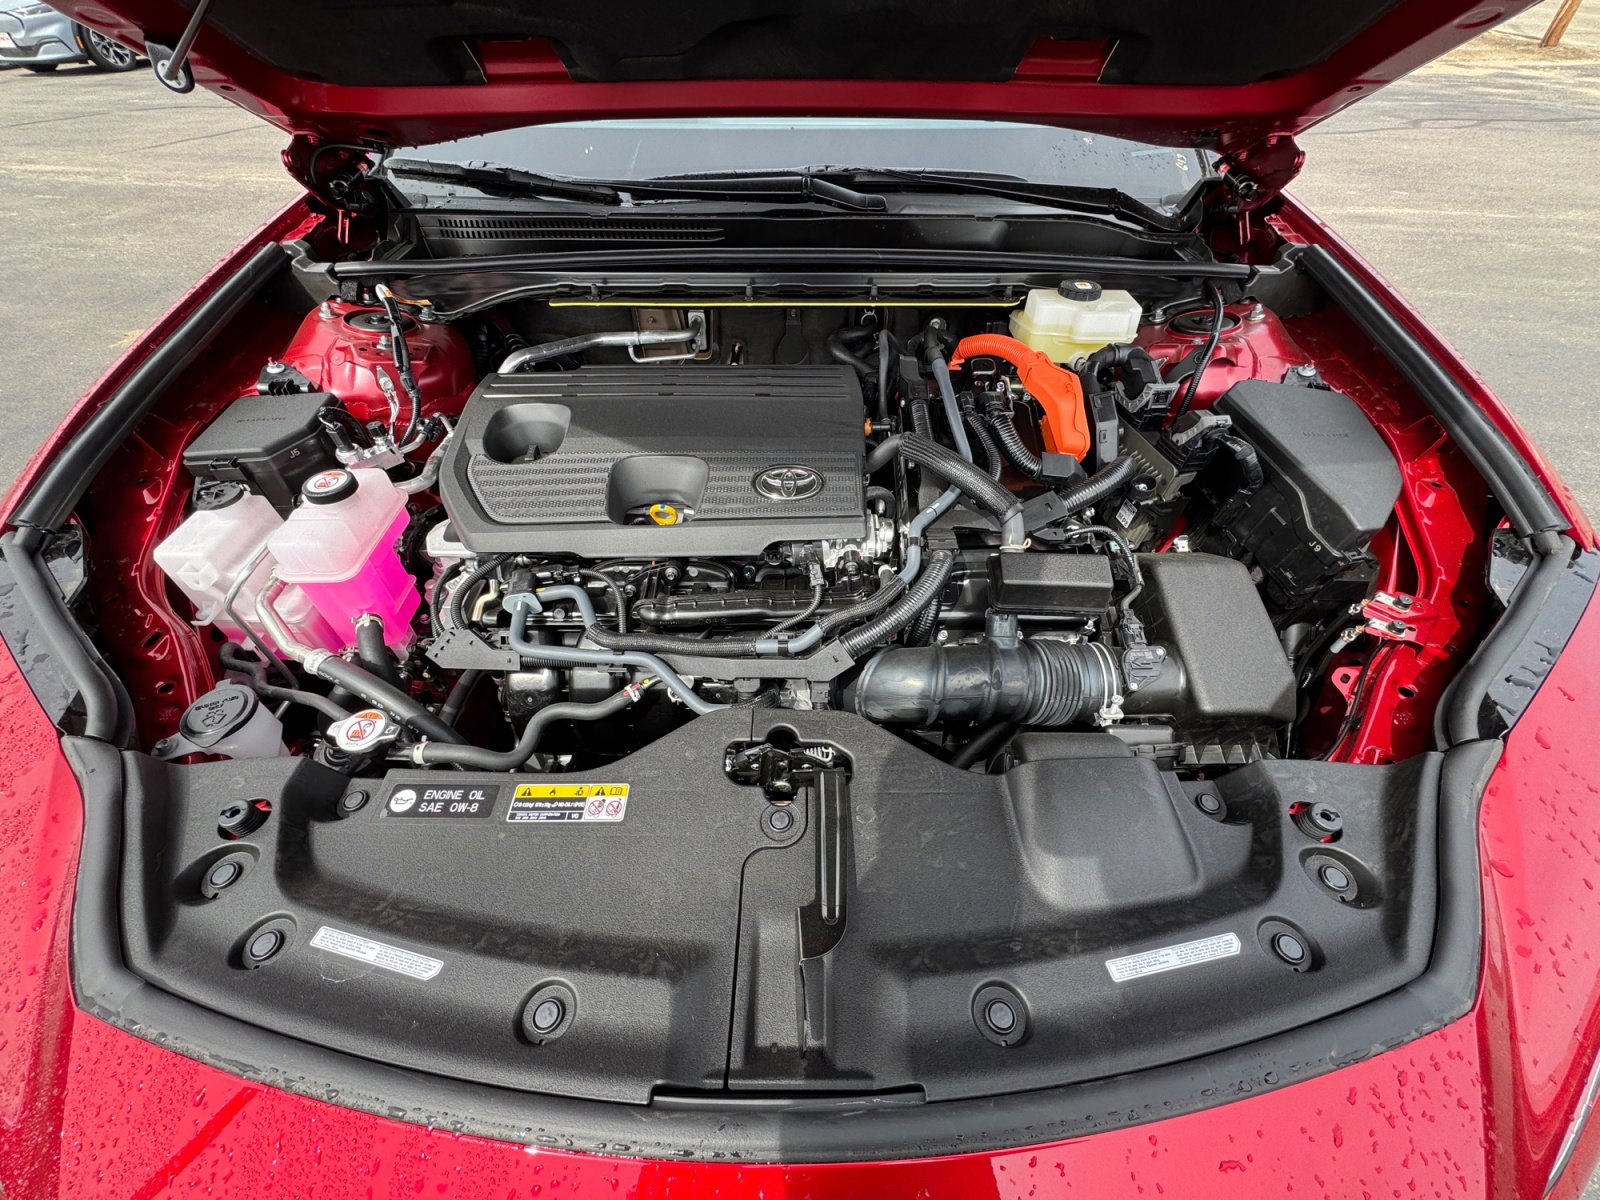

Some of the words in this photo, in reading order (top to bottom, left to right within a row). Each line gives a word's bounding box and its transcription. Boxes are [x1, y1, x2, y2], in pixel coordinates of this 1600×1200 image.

[290, 448, 301, 459] J5
[1308, 541, 1322, 552] J9
[423, 789, 464, 800] ENGINE
[468, 790, 485, 800] OIL
[418, 802, 444, 813] SAE
[449, 802, 479, 813] 0W-8
